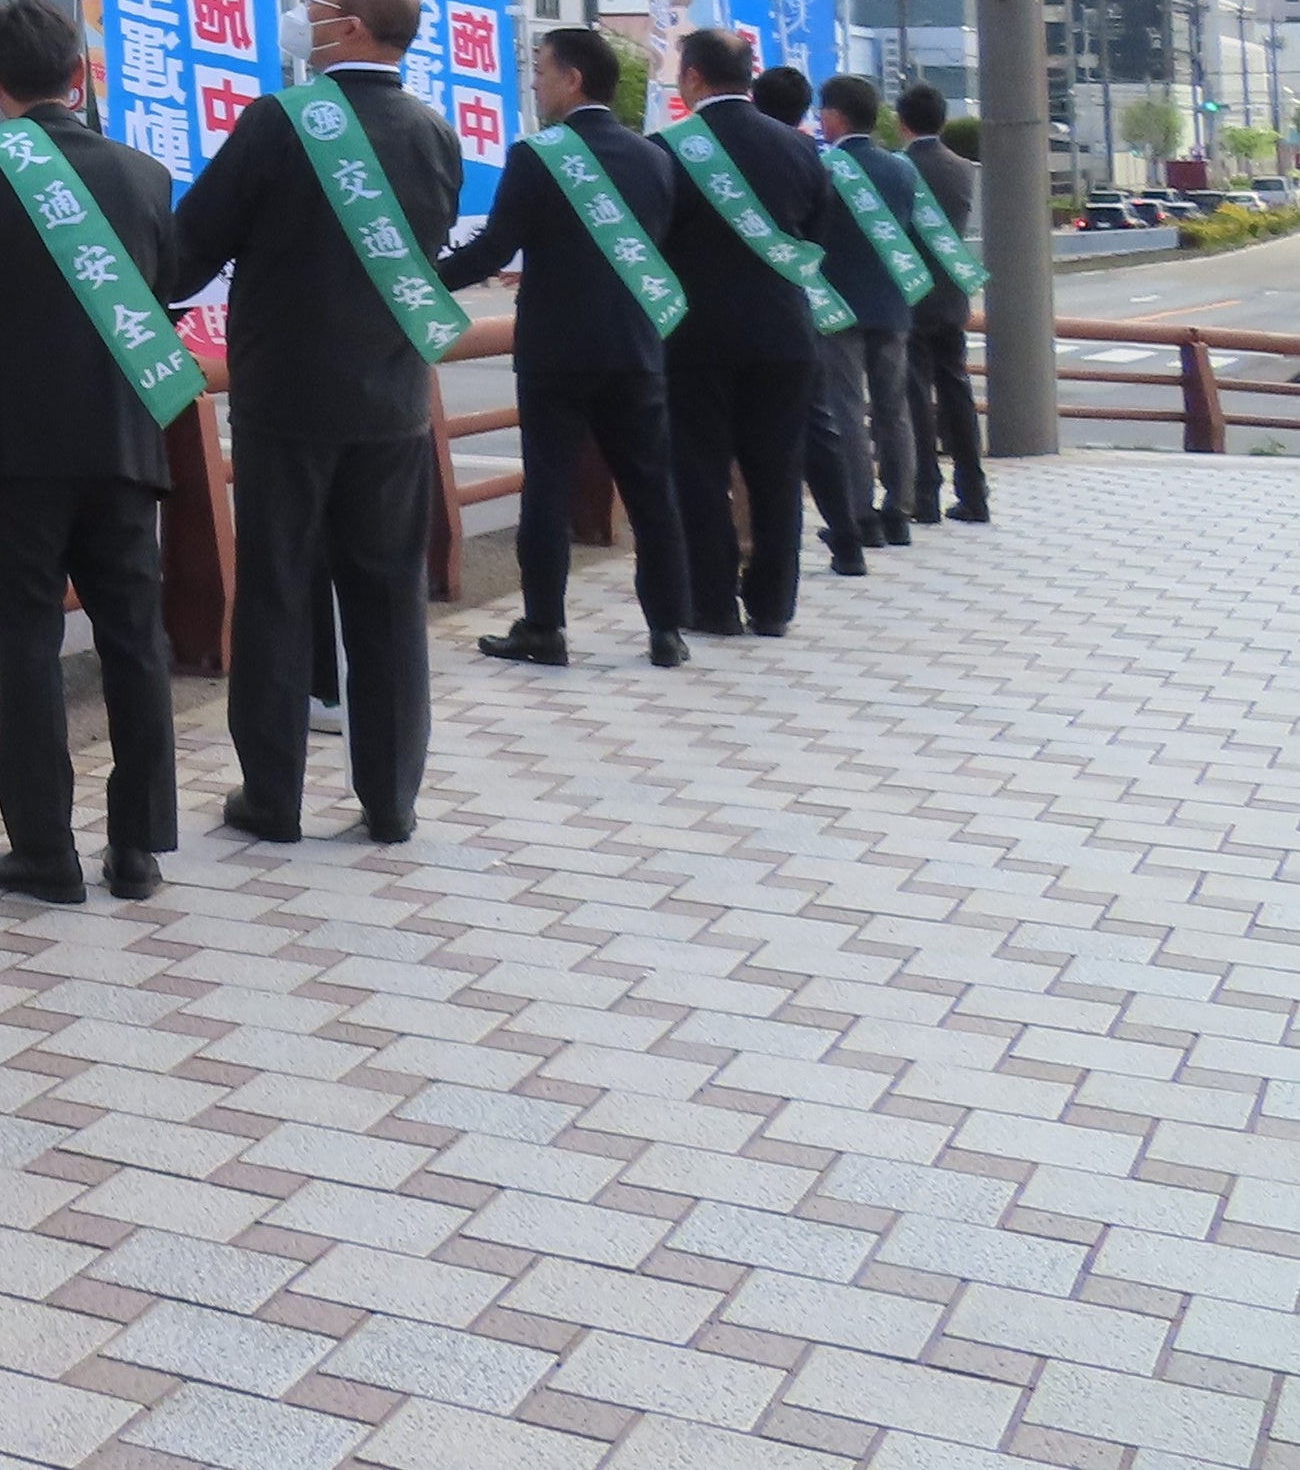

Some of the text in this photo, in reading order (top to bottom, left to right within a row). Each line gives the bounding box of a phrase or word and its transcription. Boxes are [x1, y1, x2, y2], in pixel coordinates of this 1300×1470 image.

[0, 131, 156, 350] 交通安全
[332, 159, 460, 350] 交通安全
[560, 154, 672, 301] 交通安全
[832, 160, 917, 272] 交通安全
[140, 348, 184, 390] JAF
